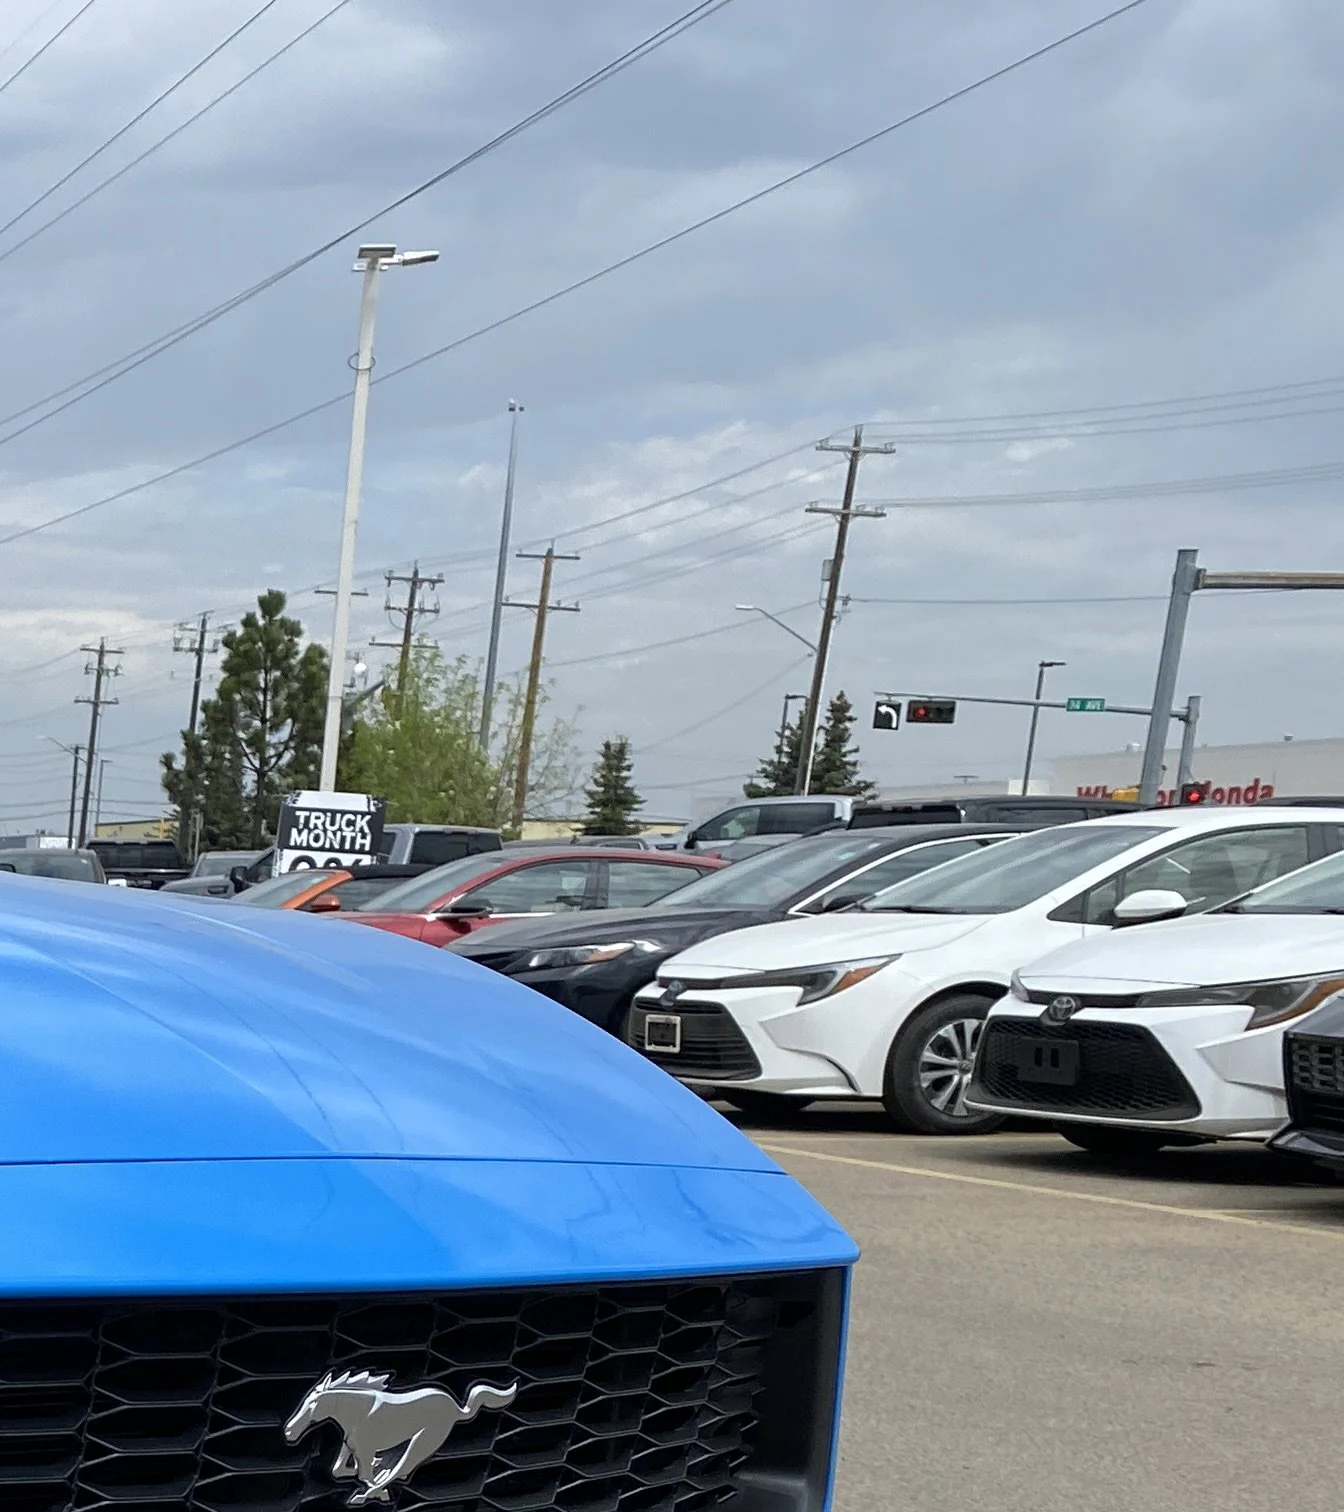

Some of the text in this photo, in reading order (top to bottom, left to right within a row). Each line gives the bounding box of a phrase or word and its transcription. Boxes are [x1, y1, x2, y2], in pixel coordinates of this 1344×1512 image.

[1202, 777, 1274, 805] onda
[295, 810, 372, 834] TRUCK
[289, 827, 372, 851] MONTH
